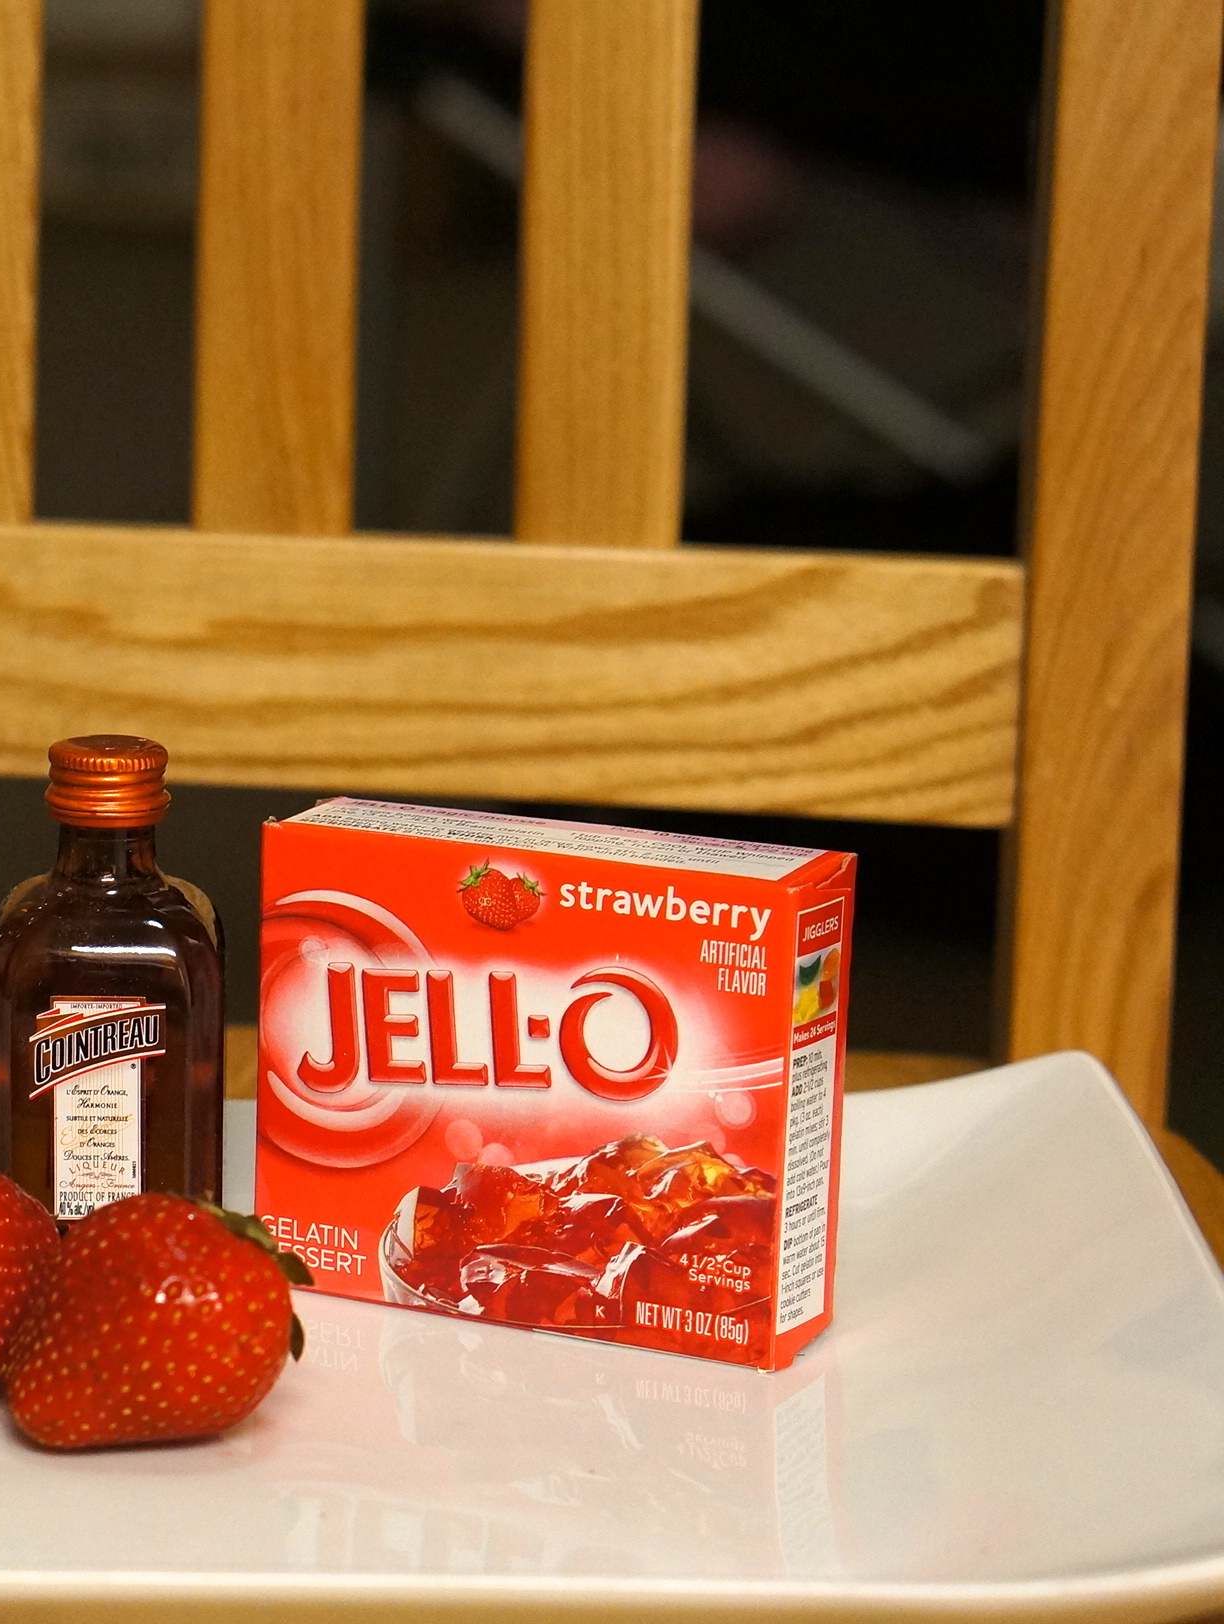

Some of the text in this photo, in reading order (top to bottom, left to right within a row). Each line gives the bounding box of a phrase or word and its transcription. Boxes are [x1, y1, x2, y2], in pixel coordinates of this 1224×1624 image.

[722, 840, 814, 854] refrigerating
[559, 881, 772, 940] strawberry
[802, 916, 839, 942] JIGGLERS
[700, 939, 767, 970] ARTIFICIAL
[717, 968, 766, 996] FLAVOR
[794, 1020, 836, 1044] Makes 24 Servings
[34, 1014, 160, 1086] COINTREAU
[793, 1055, 808, 1068] PREP:
[803, 1060, 828, 1078] refrigerating
[792, 1084, 802, 1098] ADD
[76, 1097, 118, 1108] HARMONIE
[790, 1098, 806, 1112] boiling
[806, 1094, 818, 1106] water
[790, 1127, 804, 1144] gelatin
[798, 1139, 808, 1153] until
[809, 1131, 830, 1148] completely
[69, 1160, 125, 1175] LIQUEUR
[786, 1174, 796, 1186] add
[796, 1170, 806, 1184] cold
[820, 1160, 829, 1173] Pour
[60, 1178, 135, 1191] Angers France
[786, 1190, 795, 1201] into
[60, 1191, 93, 1202] PRODUCT
[96, 1191, 105, 1202] OF
[785, 1194, 818, 1219] REFRIGERATE
[260, 1214, 358, 1250] GELATIN
[788, 1218, 801, 1232] hours
[802, 1216, 807, 1226] or
[807, 1210, 816, 1224] until
[784, 1238, 793, 1251] DIP
[793, 1230, 809, 1247] bottom
[782, 1253, 795, 1265] warm
[796, 1247, 808, 1260] water
[808, 1240, 820, 1254] about
[680, 1254, 751, 1278] 4 1/2-Cup
[792, 1263, 800, 1276] Cut
[800, 1256, 814, 1275] gelatin
[814, 1253, 823, 1264] into
[688, 1268, 751, 1293] Servings
[795, 1274, 811, 1290] squares
[812, 1272, 816, 1282] or
[816, 1266, 824, 1279] use
[780, 1288, 811, 1310] cookie cutters
[596, 1305, 605, 1318] K
[636, 1302, 749, 1345] NET WT 3 OZ (85g)
